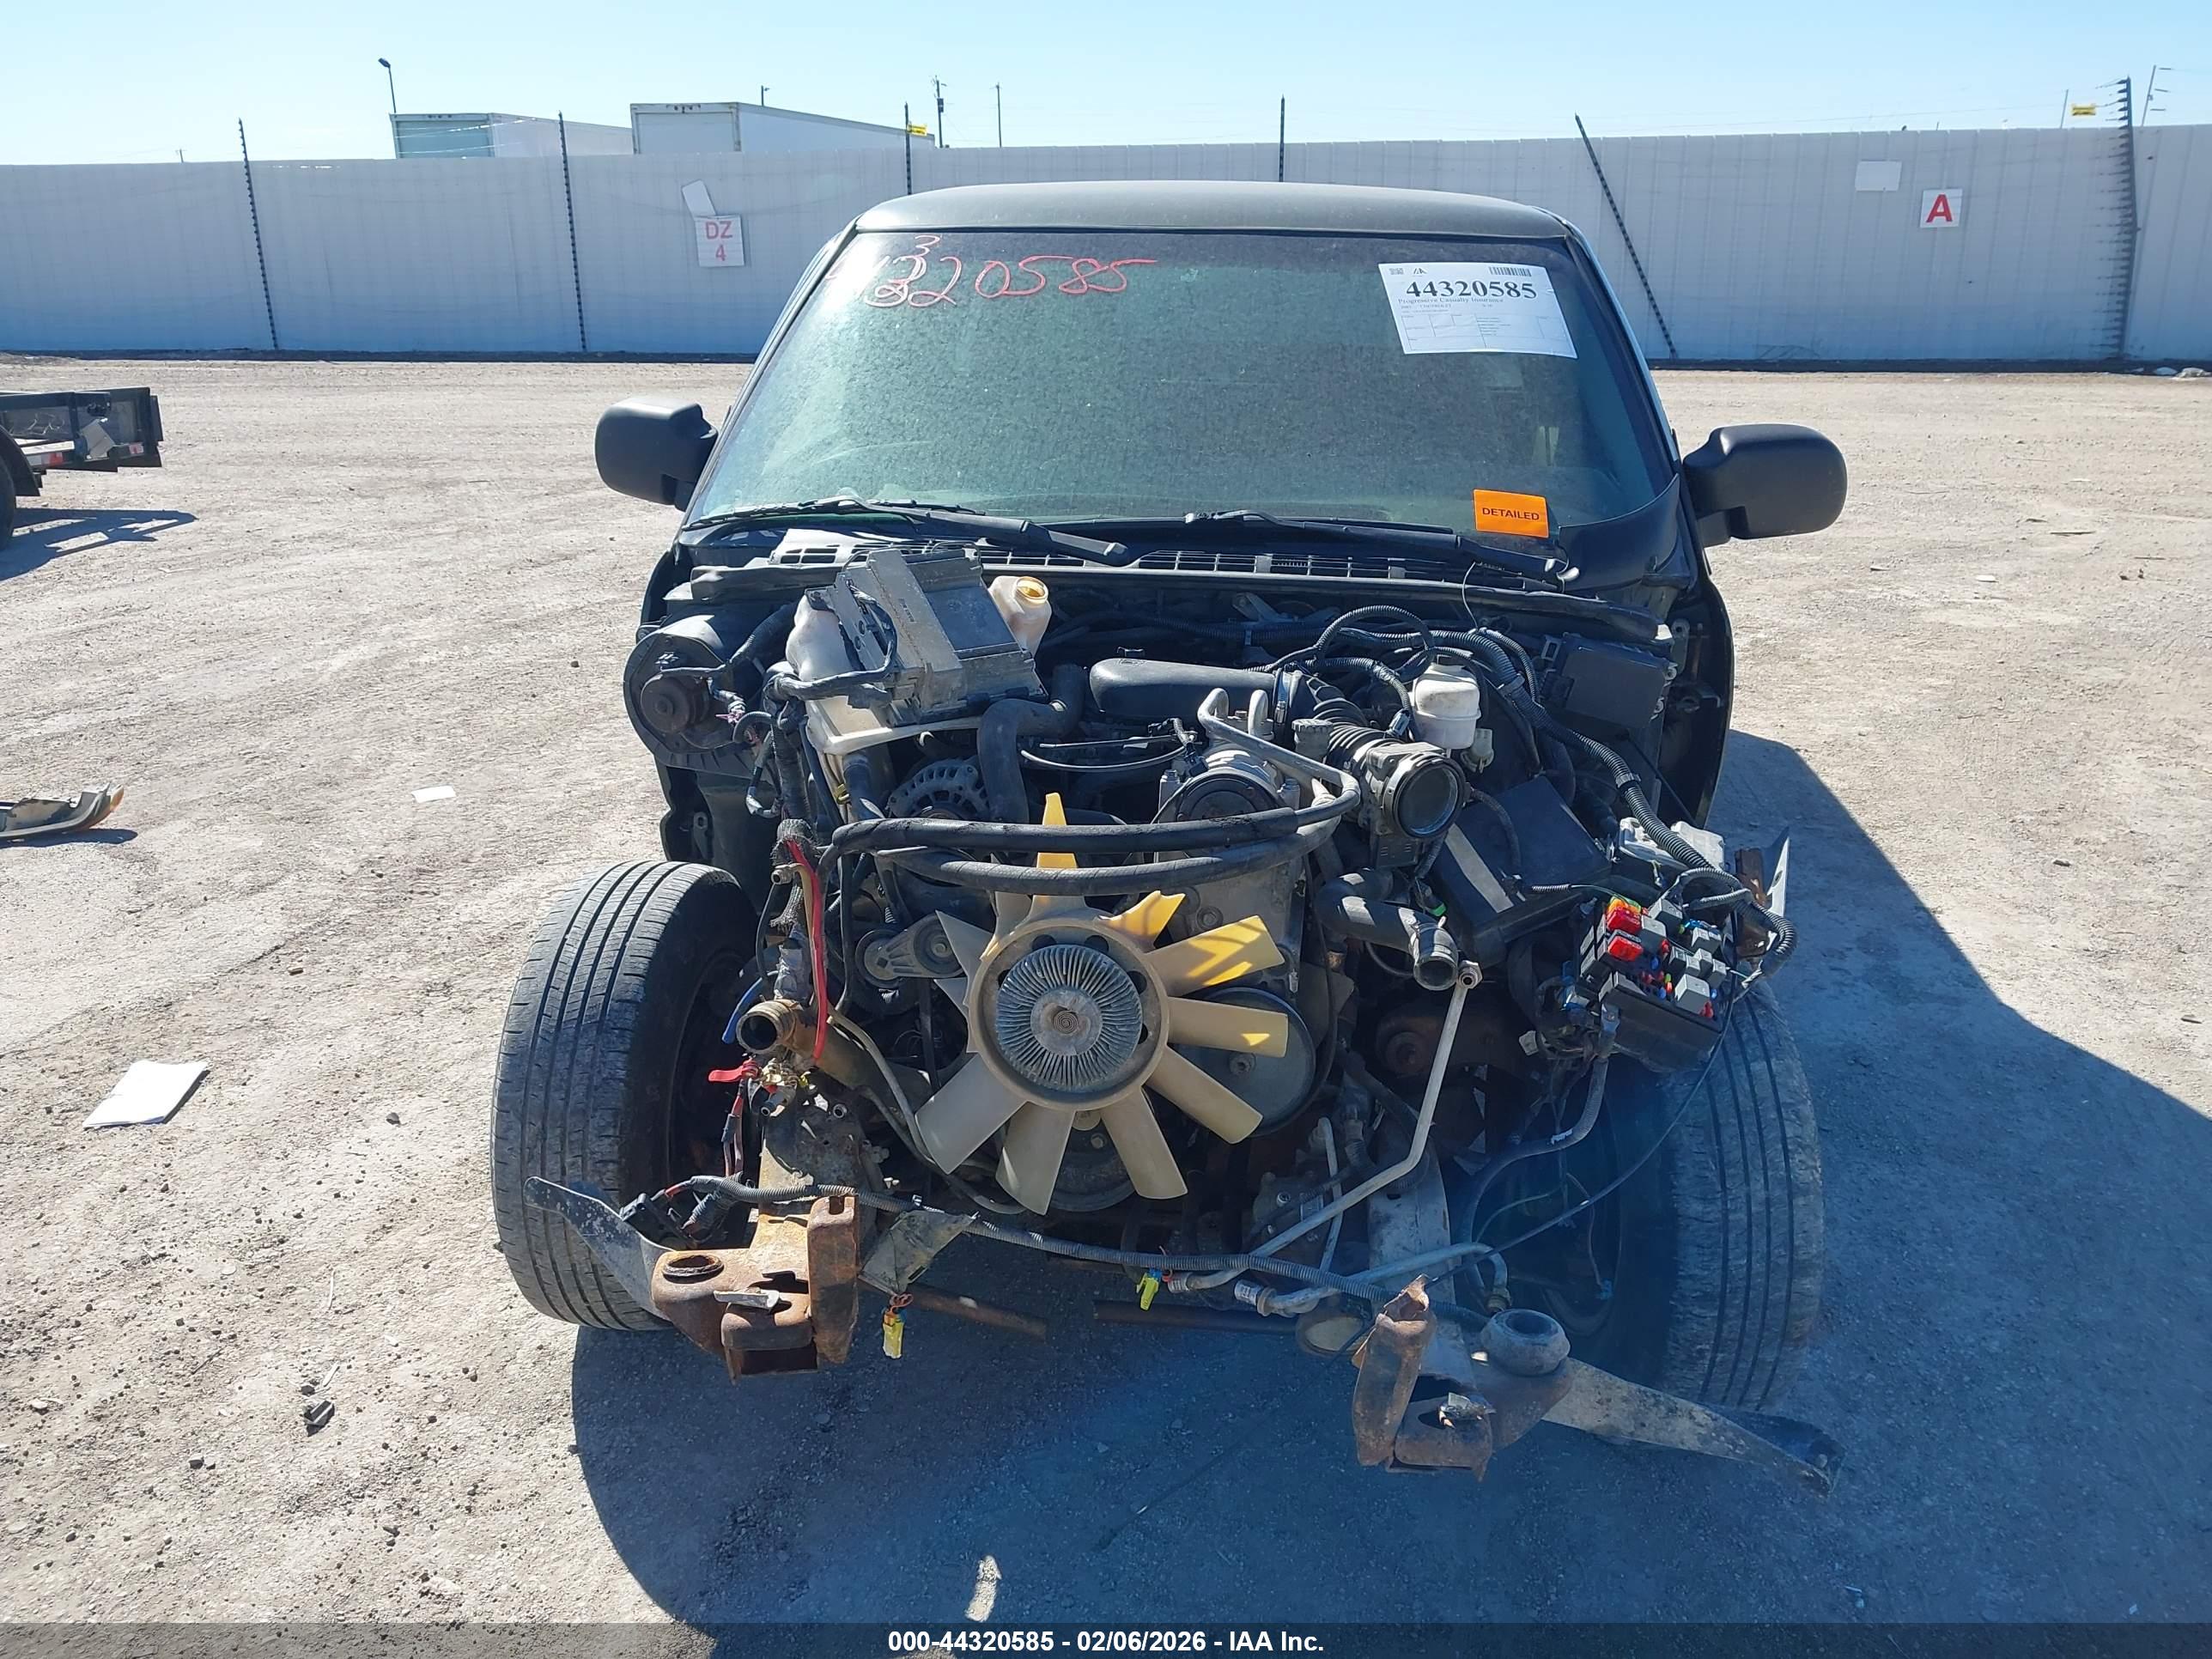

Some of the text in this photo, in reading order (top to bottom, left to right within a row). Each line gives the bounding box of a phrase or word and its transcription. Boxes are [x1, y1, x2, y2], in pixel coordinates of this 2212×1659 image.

[1925, 193, 1954, 223] A
[705, 221, 733, 240] DZ
[715, 244, 727, 262] 4
[1406, 280, 1537, 299] 44320585
[1482, 507, 1540, 520] DETAILED
